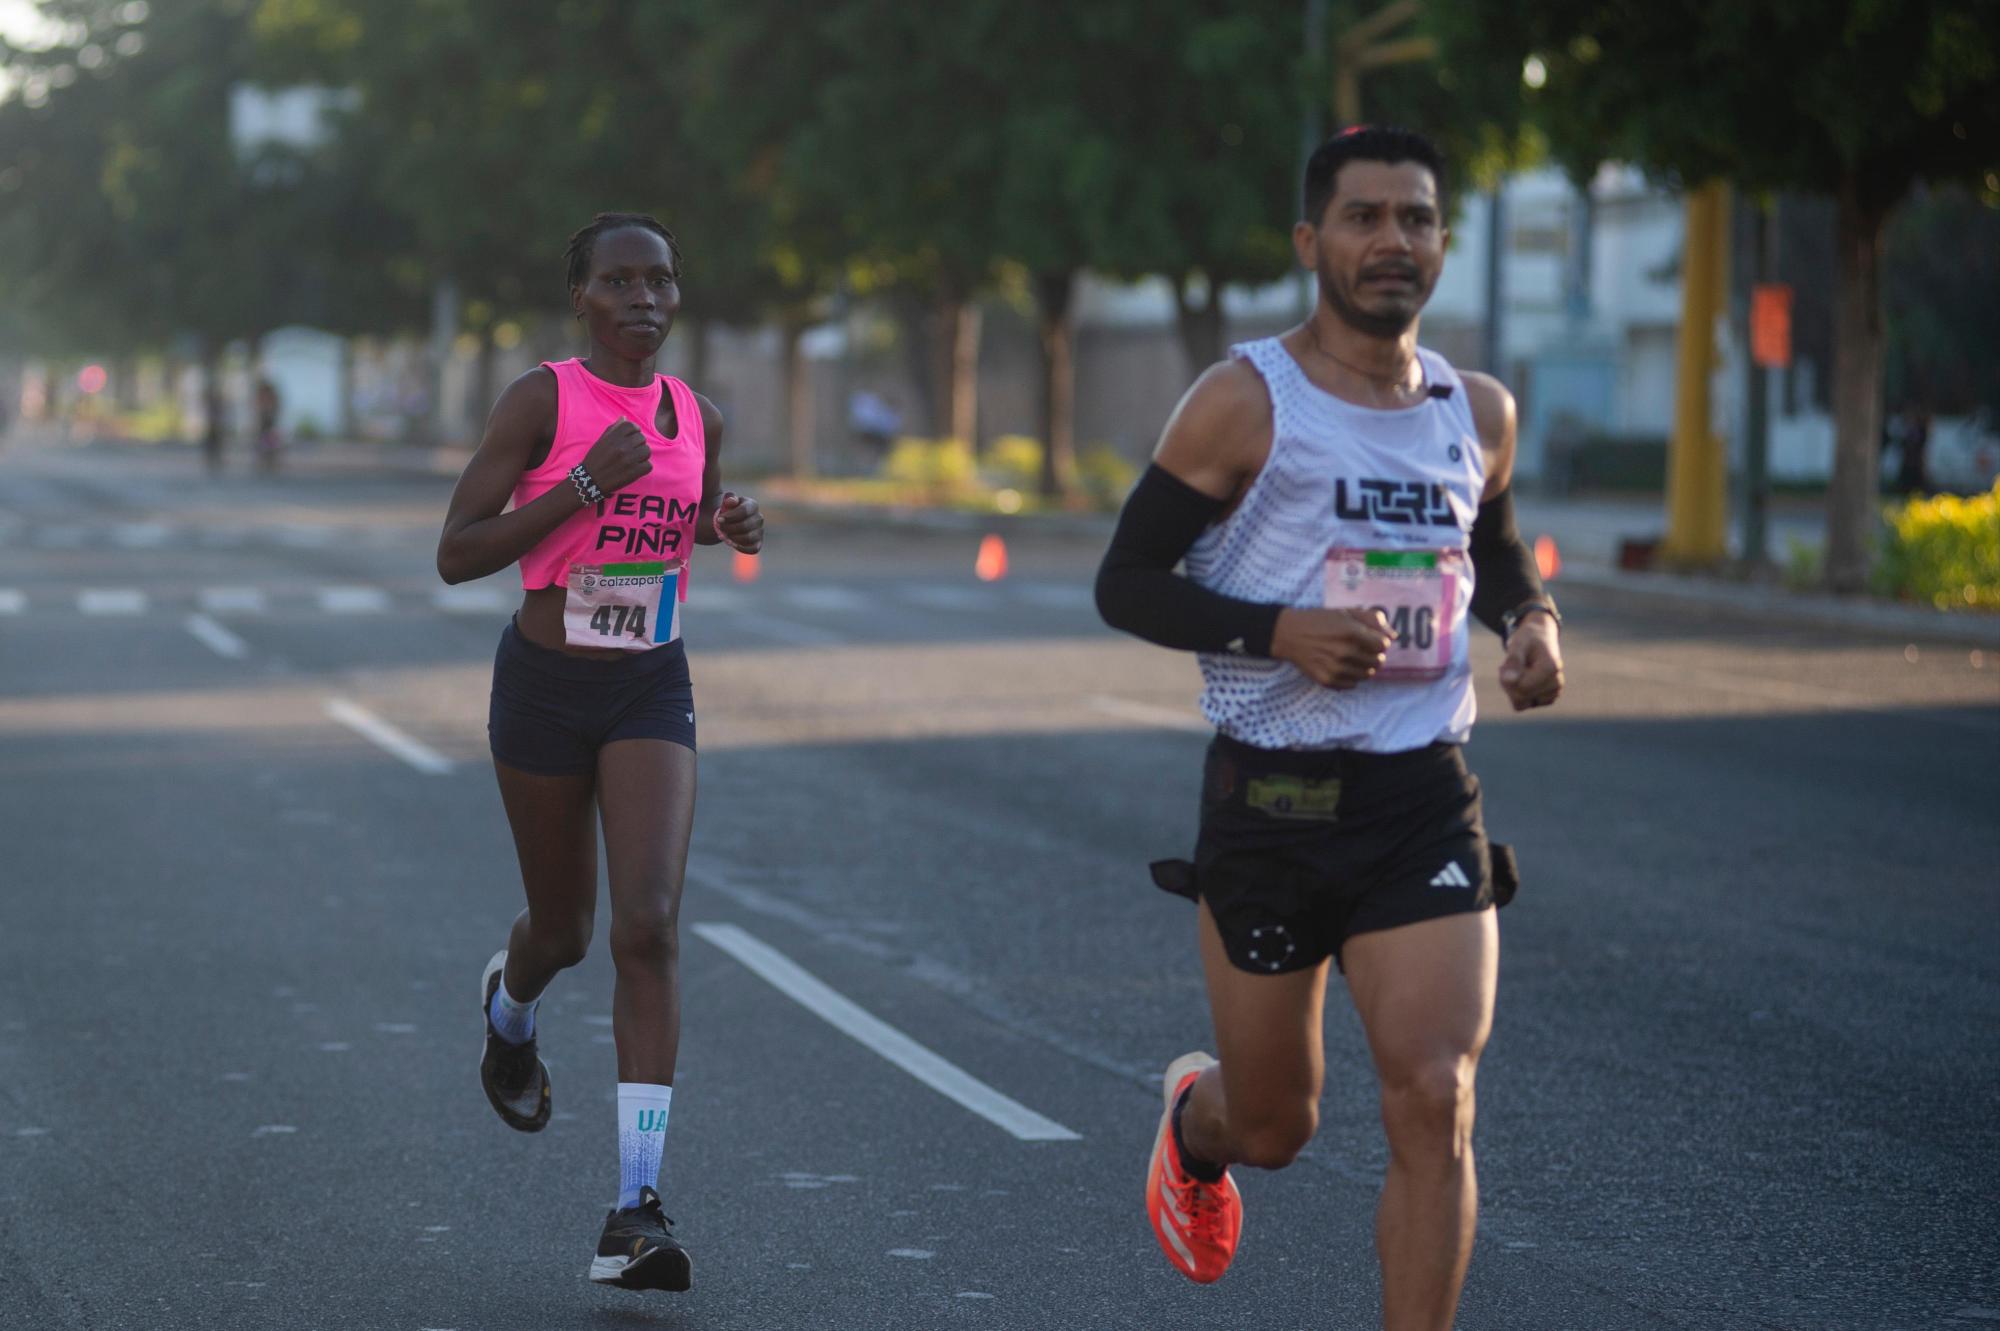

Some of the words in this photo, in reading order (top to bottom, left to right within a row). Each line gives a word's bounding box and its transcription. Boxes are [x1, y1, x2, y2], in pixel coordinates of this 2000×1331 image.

[596, 493, 697, 524] TEAM
[595, 522, 682, 555] PIÑA
[590, 604, 646, 638] 474
